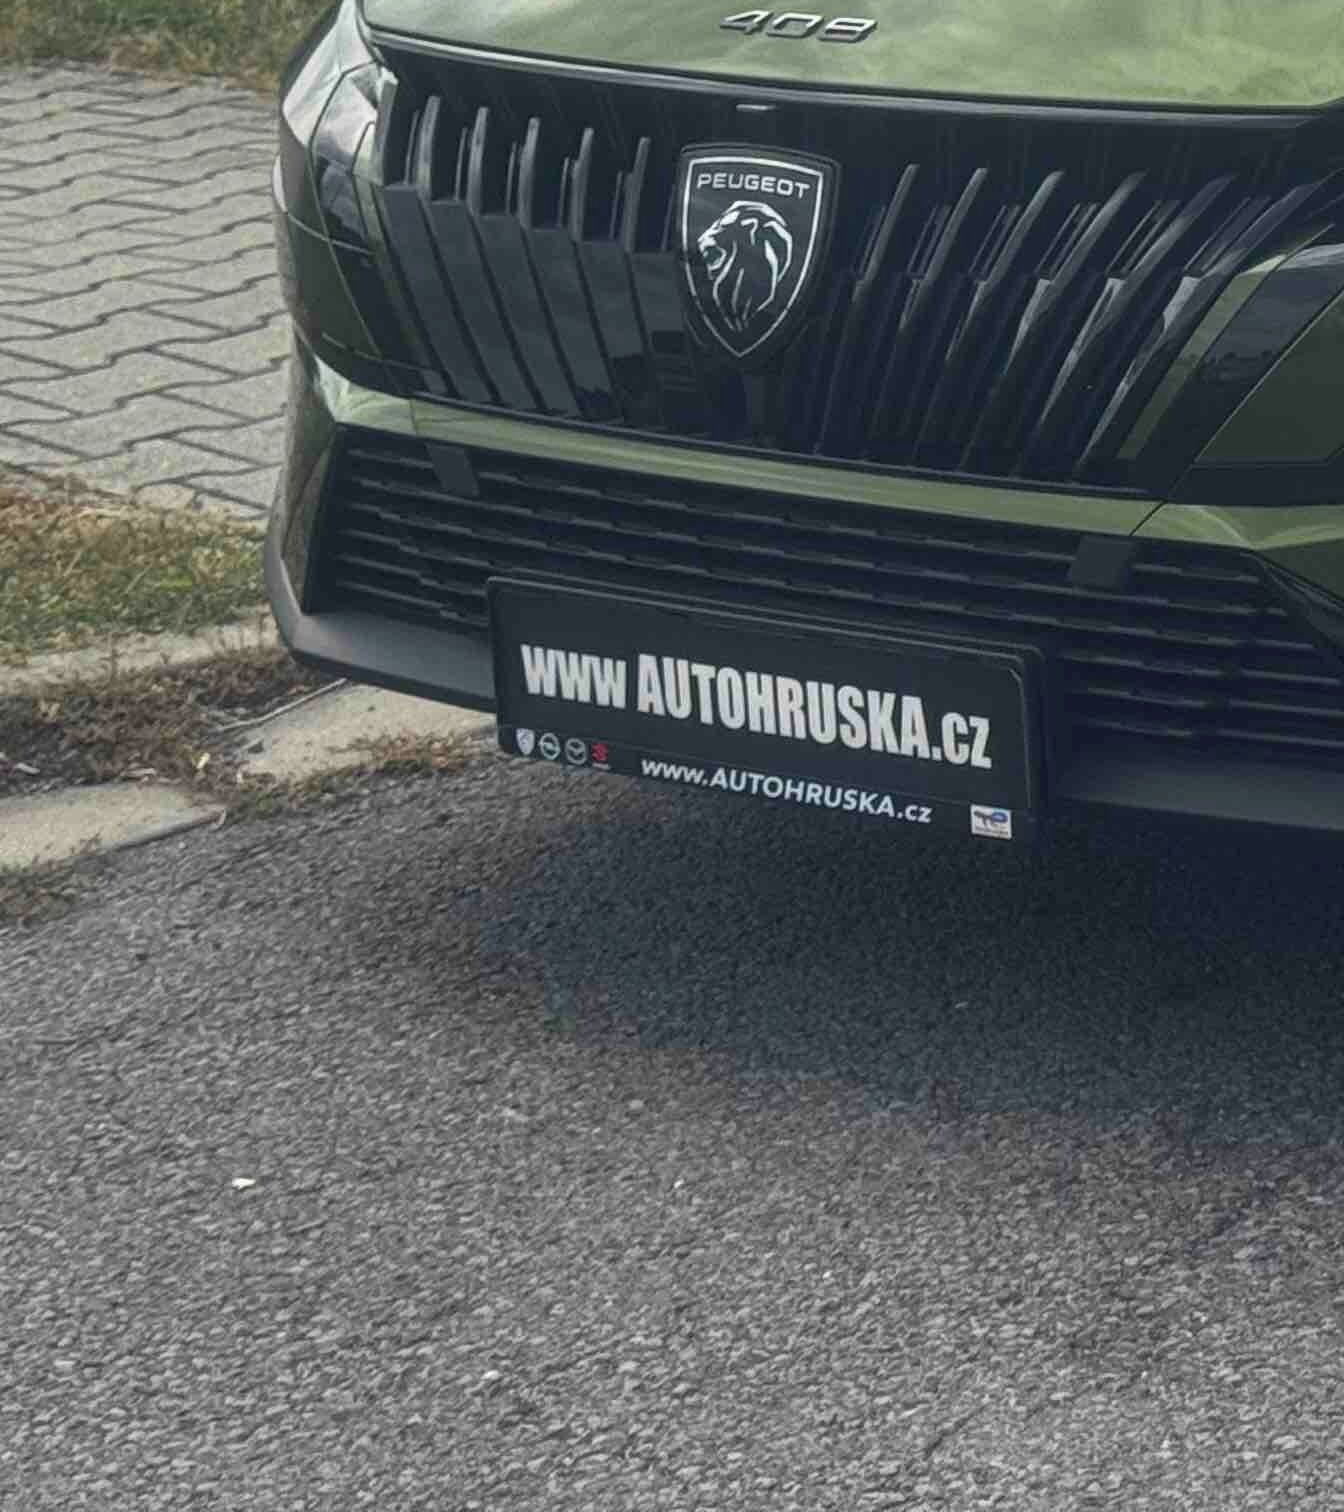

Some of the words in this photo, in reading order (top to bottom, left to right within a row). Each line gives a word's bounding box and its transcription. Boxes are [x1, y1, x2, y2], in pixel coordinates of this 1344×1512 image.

[719, 9, 878, 43] 408
[697, 172, 811, 199] PEUGEOT
[520, 644, 627, 709] WWW
[637, 653, 993, 769] AUTOHRUSKA.CZ
[641, 758, 933, 824] www.AUTOHRUSKA.cz
